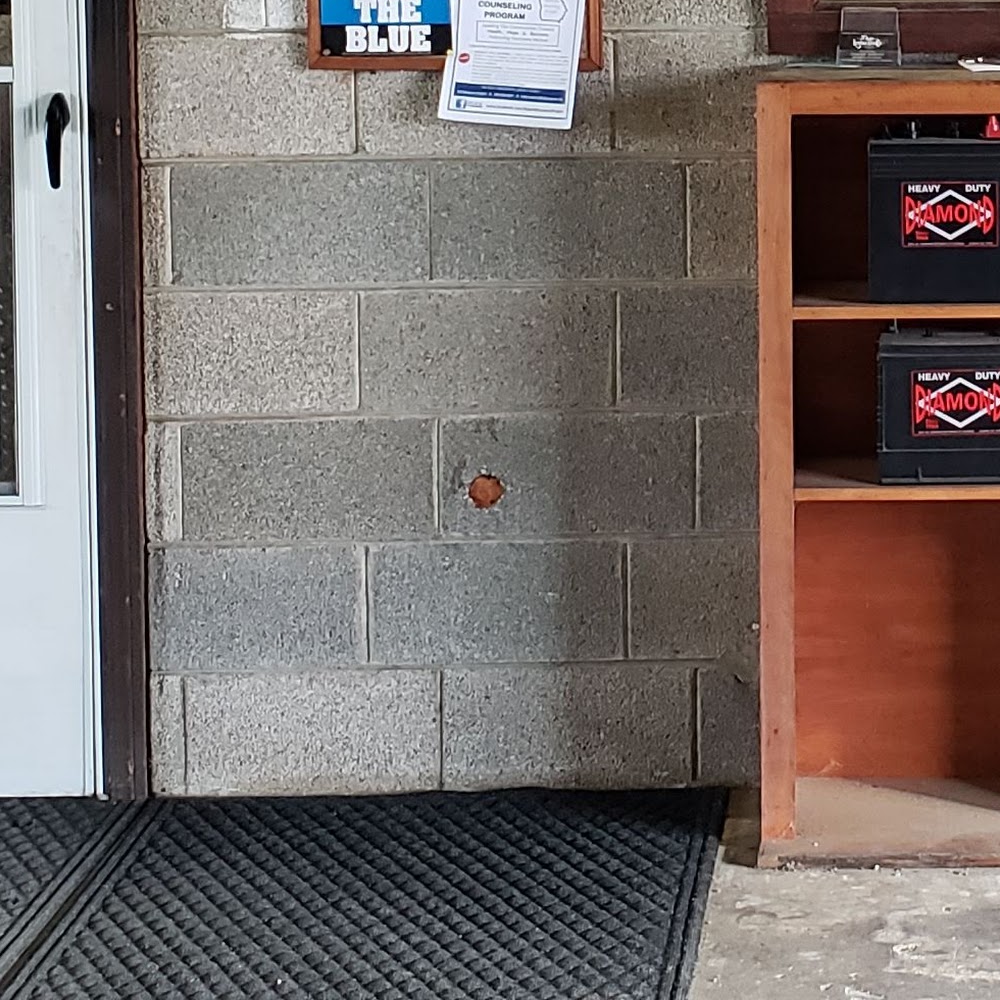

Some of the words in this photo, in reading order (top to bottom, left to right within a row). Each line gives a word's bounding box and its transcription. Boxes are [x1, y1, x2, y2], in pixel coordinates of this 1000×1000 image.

[478, 0, 532, 10] COUNSELING
[484, 11, 526, 20] PROGRAM
[345, 25, 431, 53] BLUE
[908, 184, 941, 193] HEAVY
[965, 184, 991, 193] DUTY
[918, 372, 951, 381] HEAVY
[975, 371, 1000, 380] DUTY
